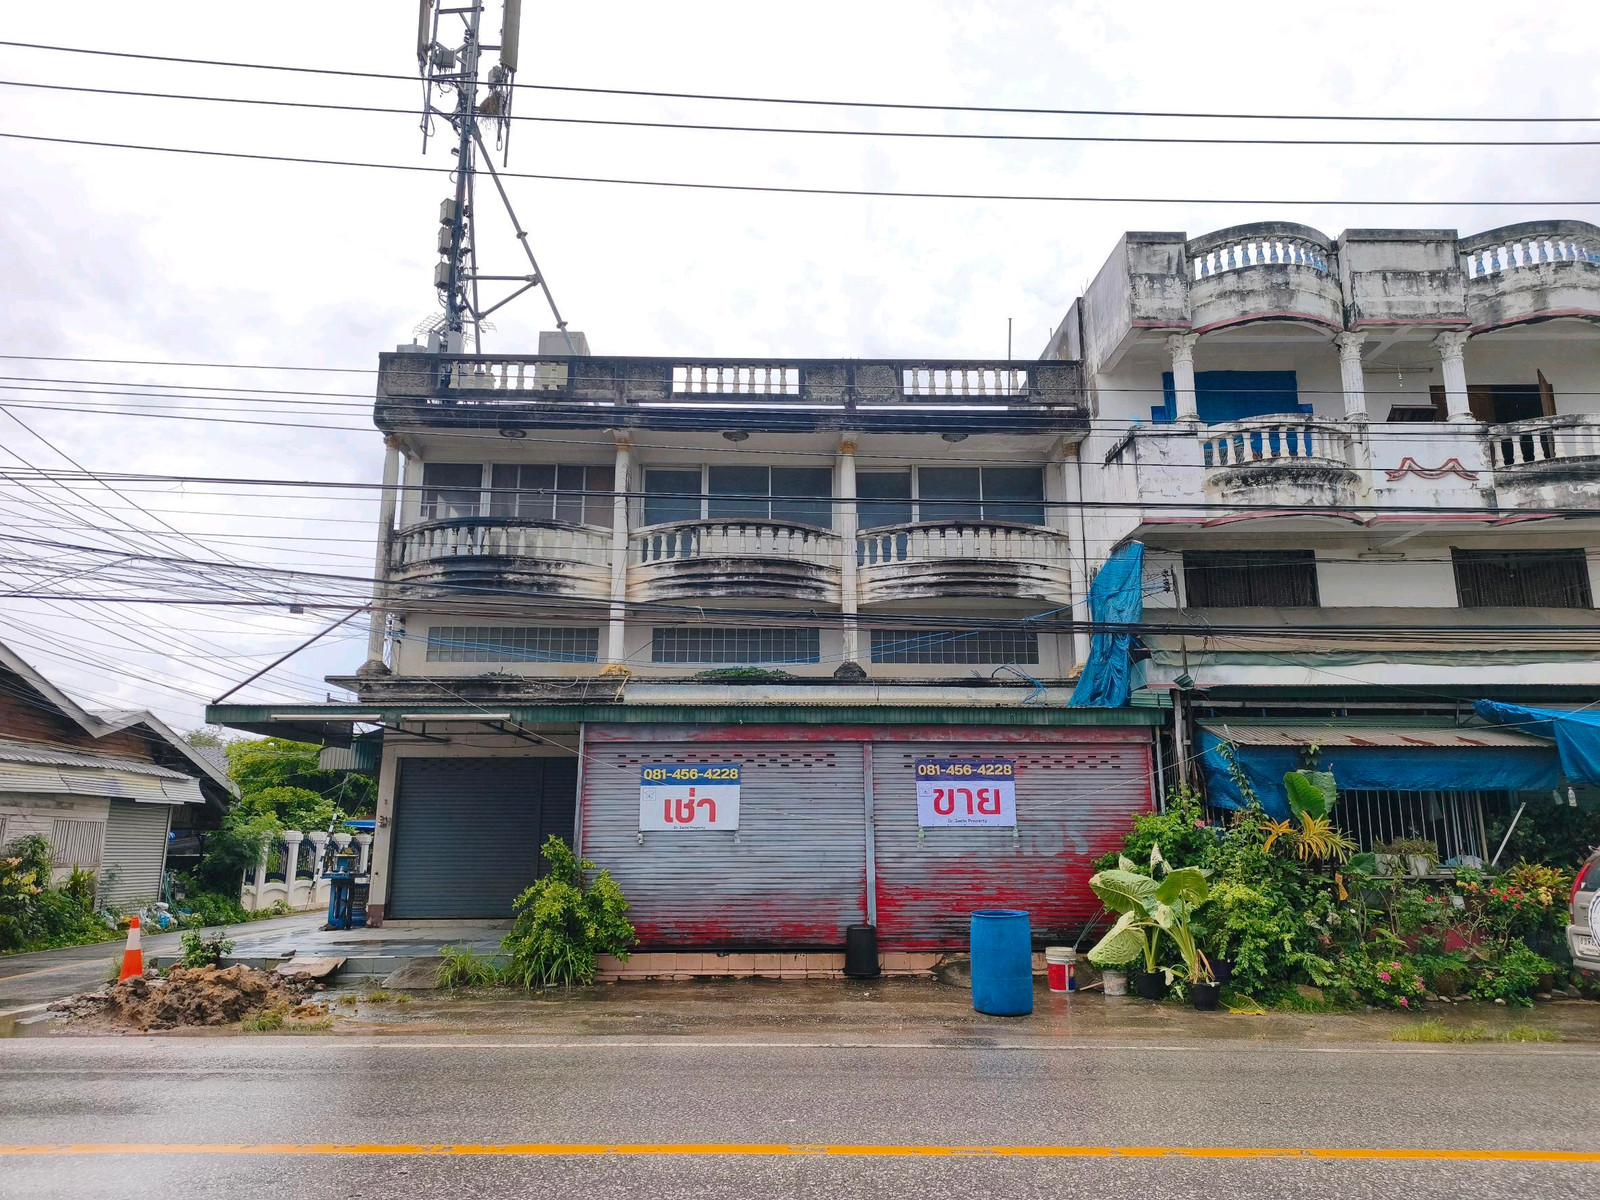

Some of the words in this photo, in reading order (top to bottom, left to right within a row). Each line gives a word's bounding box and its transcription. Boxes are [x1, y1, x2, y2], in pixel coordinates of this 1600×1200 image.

[643, 768, 739, 780] 081-456-4228
[917, 764, 1012, 775] 081-456-4228
[663, 787, 716, 823] เช่า
[933, 788, 1001, 815] ขาย
